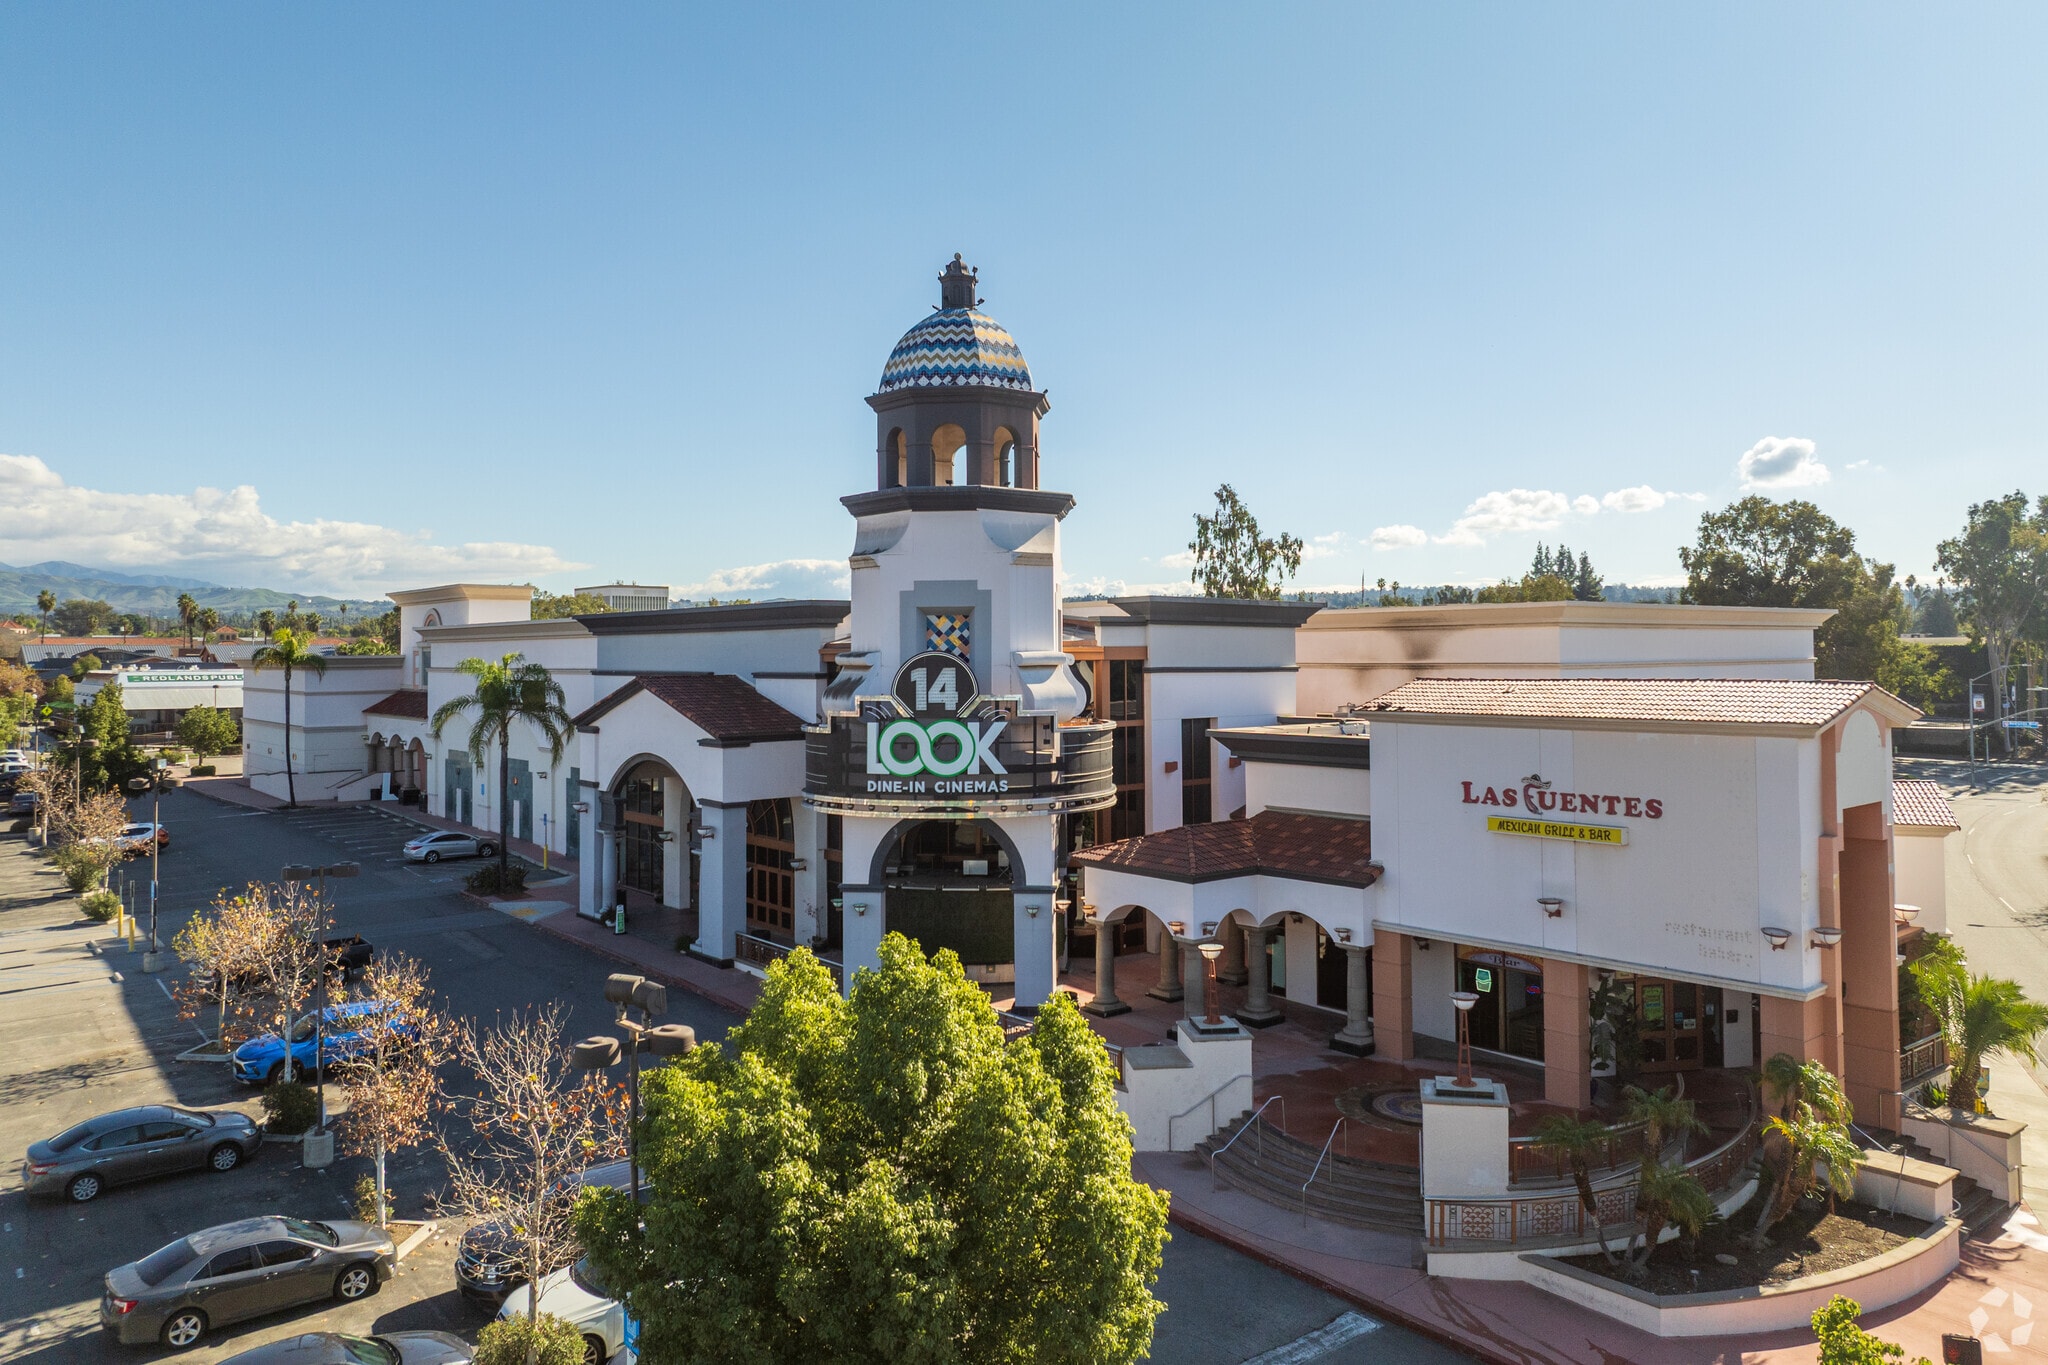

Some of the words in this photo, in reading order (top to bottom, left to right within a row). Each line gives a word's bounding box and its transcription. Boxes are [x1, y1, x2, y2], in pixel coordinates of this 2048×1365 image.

[911, 667, 958, 711] 14
[867, 719, 1008, 777] LOOK
[867, 780, 925, 793] DINE-IN
[934, 780, 1008, 793] CINEMAS
[1461, 781, 1518, 807] LAS
[1523, 781, 1663, 819] FUENTES
[1497, 820, 1541, 834] MEXICAN
[1545, 824, 1575, 838] GRILL
[1579, 828, 1585, 839] &
[1589, 828, 1612, 841] BAR
